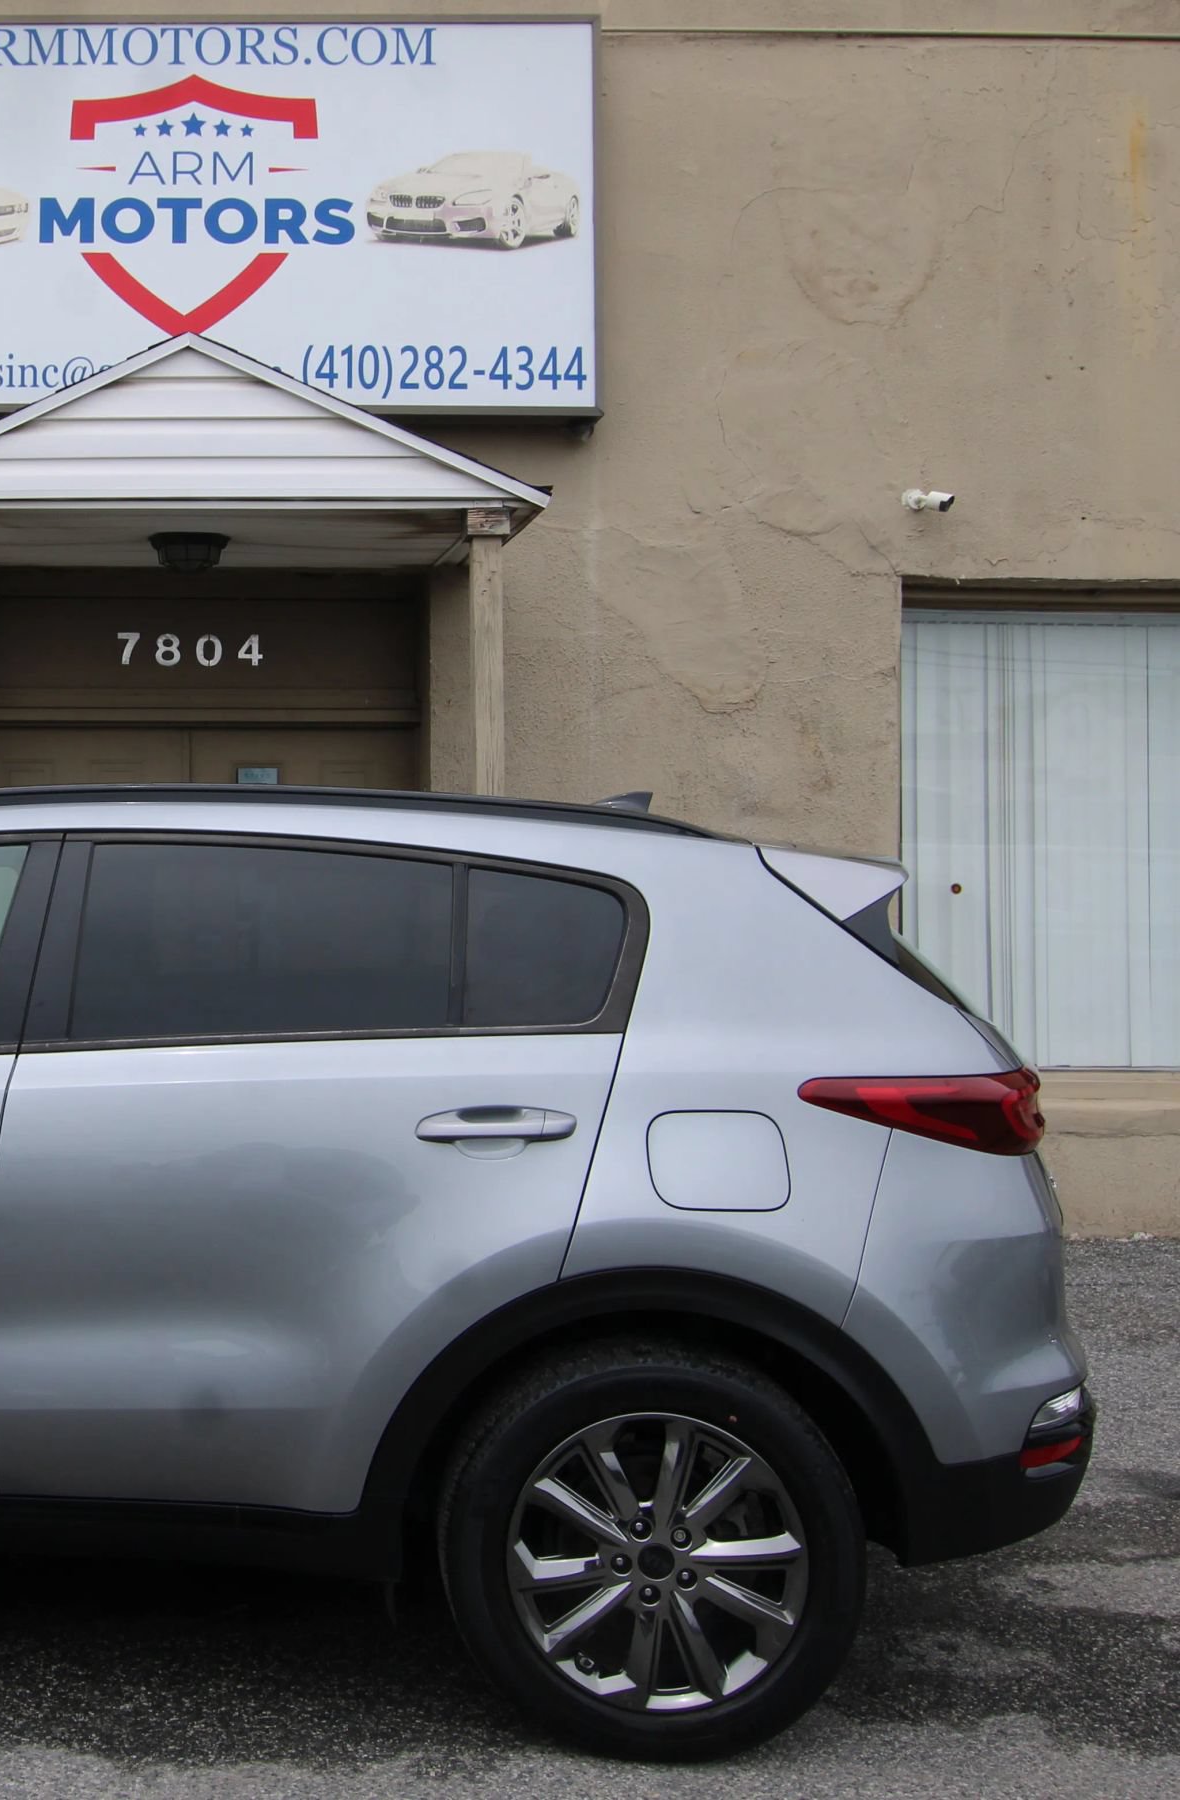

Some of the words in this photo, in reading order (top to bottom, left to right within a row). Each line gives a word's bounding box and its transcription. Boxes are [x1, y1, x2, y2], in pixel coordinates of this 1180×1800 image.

[127, 150, 256, 186] ARM
[38, 197, 356, 247] MOTORS
[301, 344, 588, 399] (410)282-4344
[117, 632, 264, 667] 7804
